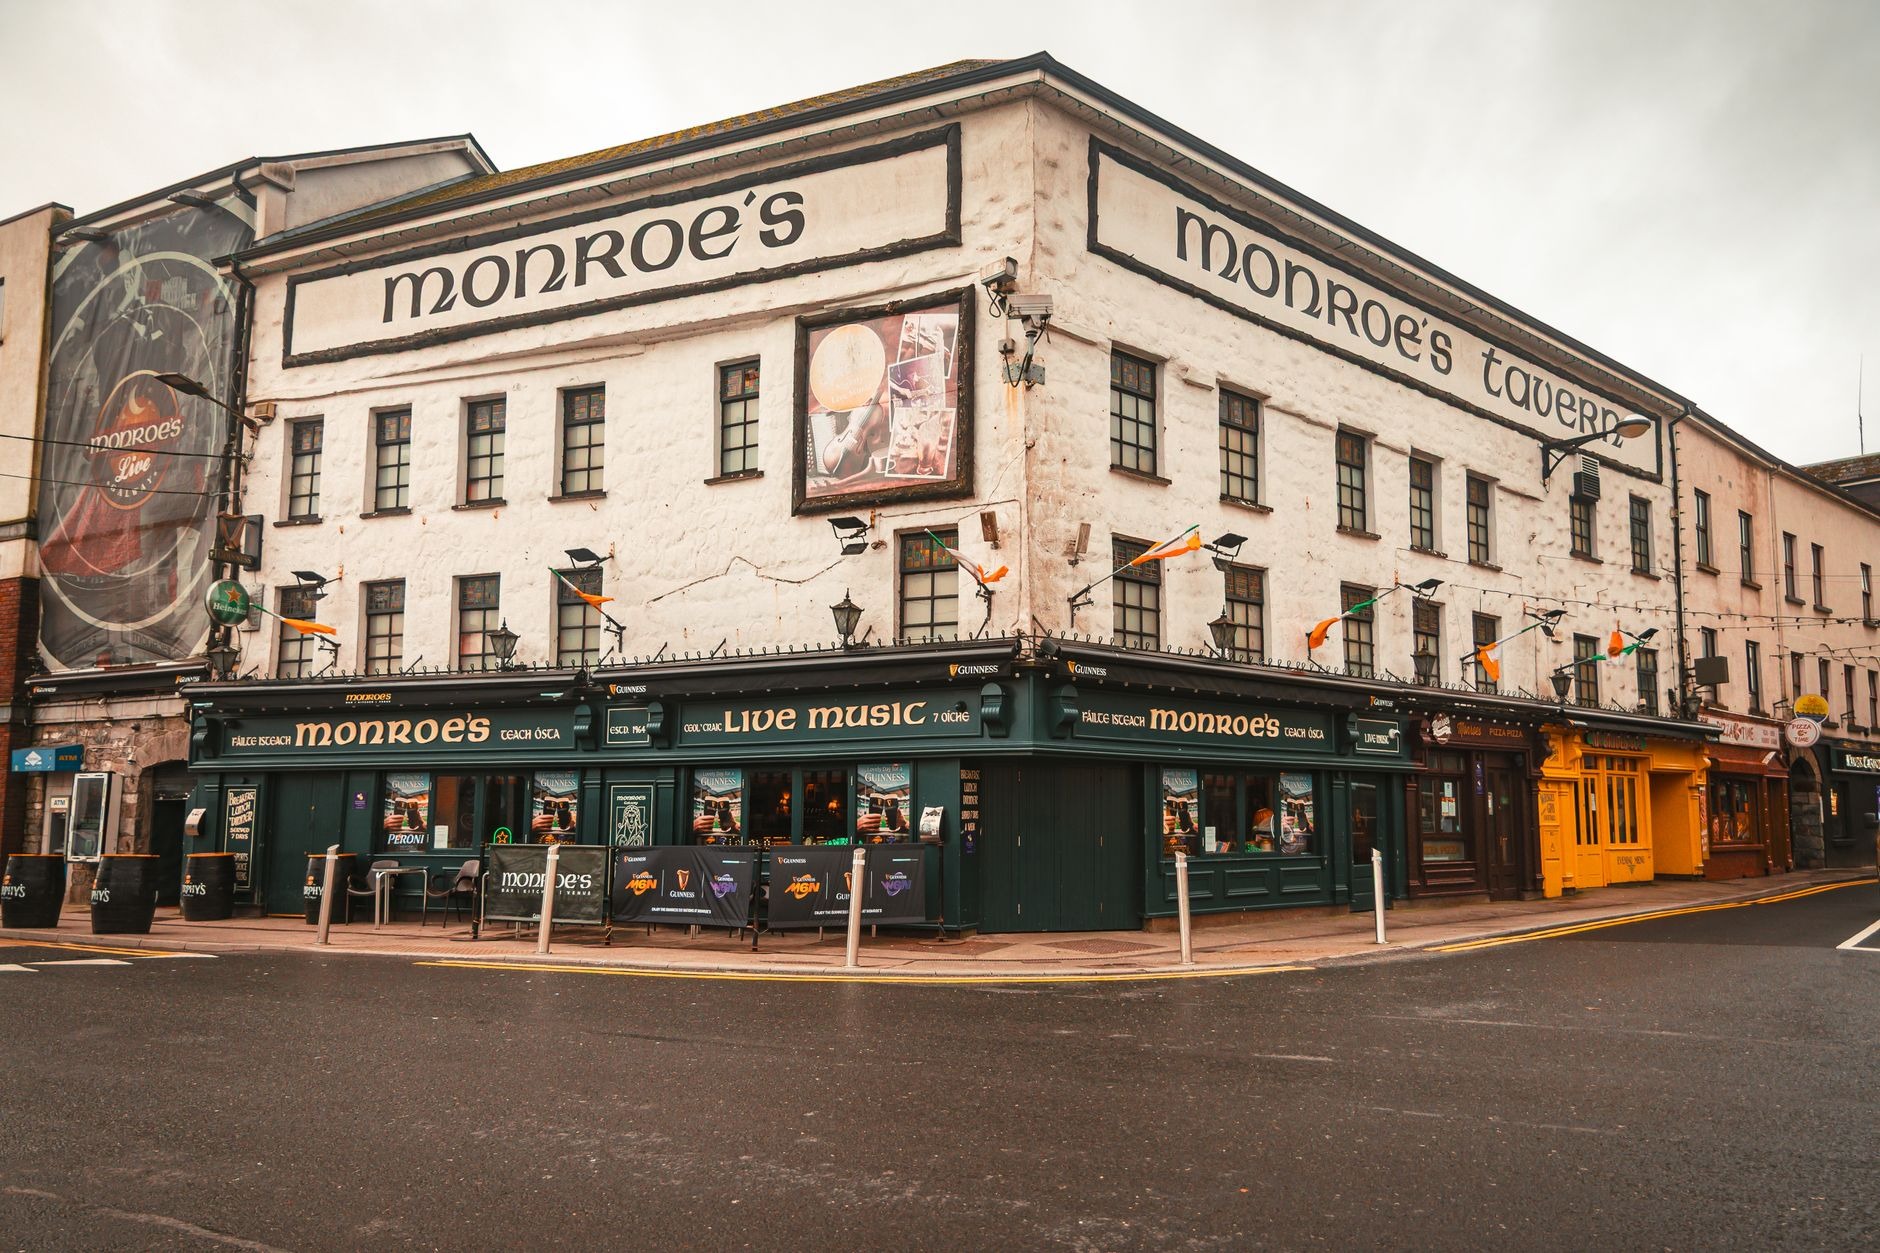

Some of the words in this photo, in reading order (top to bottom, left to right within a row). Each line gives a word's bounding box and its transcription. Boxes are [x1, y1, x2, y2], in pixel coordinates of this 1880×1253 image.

[115, 456, 151, 482] Live
[958, 665, 998, 674] GUINNESS
[1075, 664, 1107, 676] GUINNESS
[616, 685, 647, 694] GUINNESS
[933, 713, 939, 723] 7
[1111, 714, 1146, 728] ISTEACH
[1284, 727, 1306, 739] TEACH
[1308, 727, 1325, 740] ÓSTA
[258, 735, 291, 746] ISTEACH
[501, 729, 532, 741] TEACH
[534, 727, 561, 740] ÓSTA
[1489, 728, 1506, 737] PIZZA
[1506, 730, 1523, 738] PIZZA
[700, 777, 737, 786] GUINNESS
[864, 773, 905, 782] GUINNESS
[391, 780, 425, 789] GUINNESS
[540, 779, 576, 787] GUINNESS
[387, 833, 425, 845] PERONI
[670, 890, 695, 898] GUINNESS
